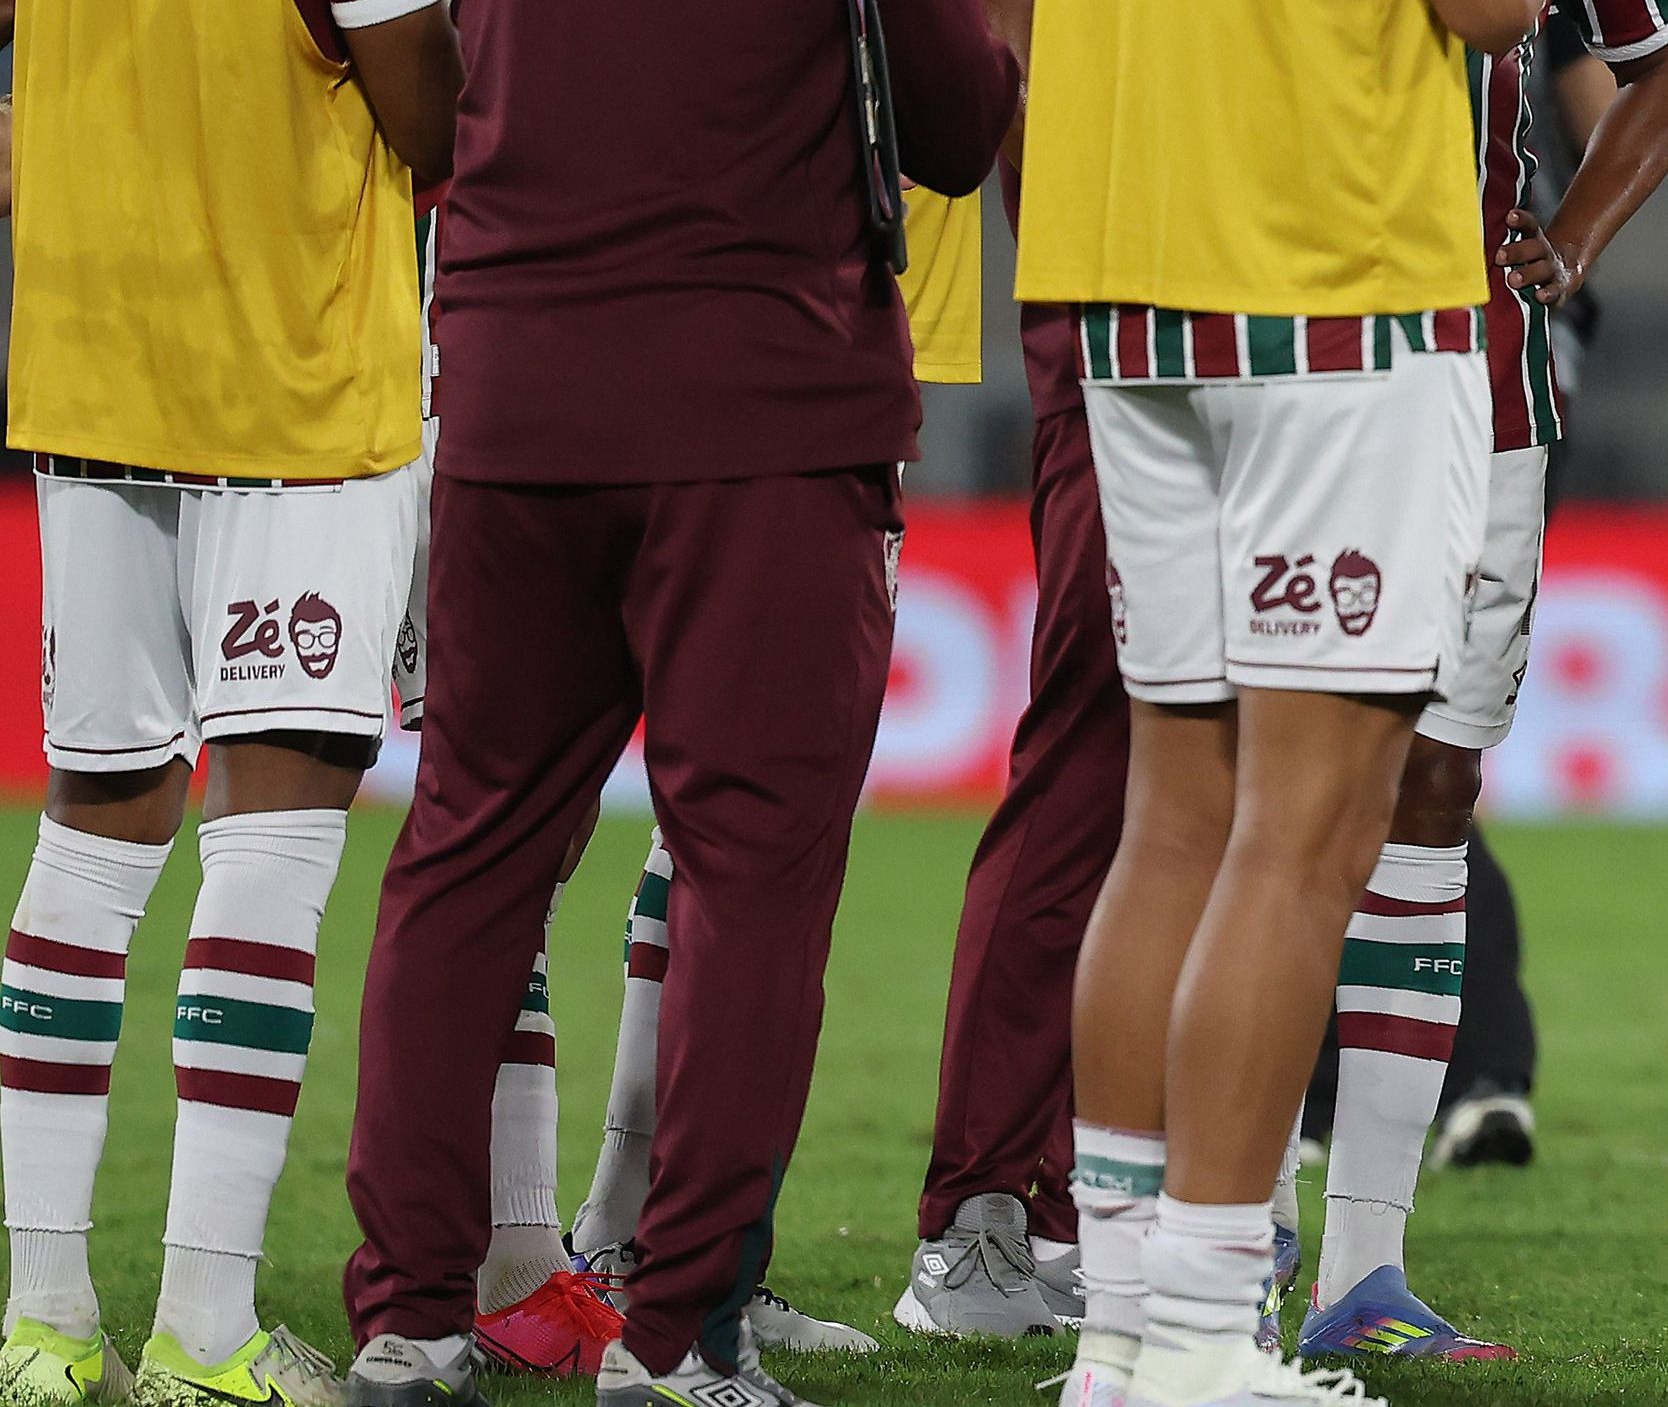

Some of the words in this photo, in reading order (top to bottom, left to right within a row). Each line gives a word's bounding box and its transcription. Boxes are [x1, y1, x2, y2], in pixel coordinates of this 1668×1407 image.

[1250, 554, 1322, 613] Zé
[220, 599, 286, 661] Zé
[220, 663, 286, 681] DELIVERY
[1414, 957, 1463, 975] FFC
[1, 996, 53, 1020] FFC
[176, 1005, 223, 1024] FFC
